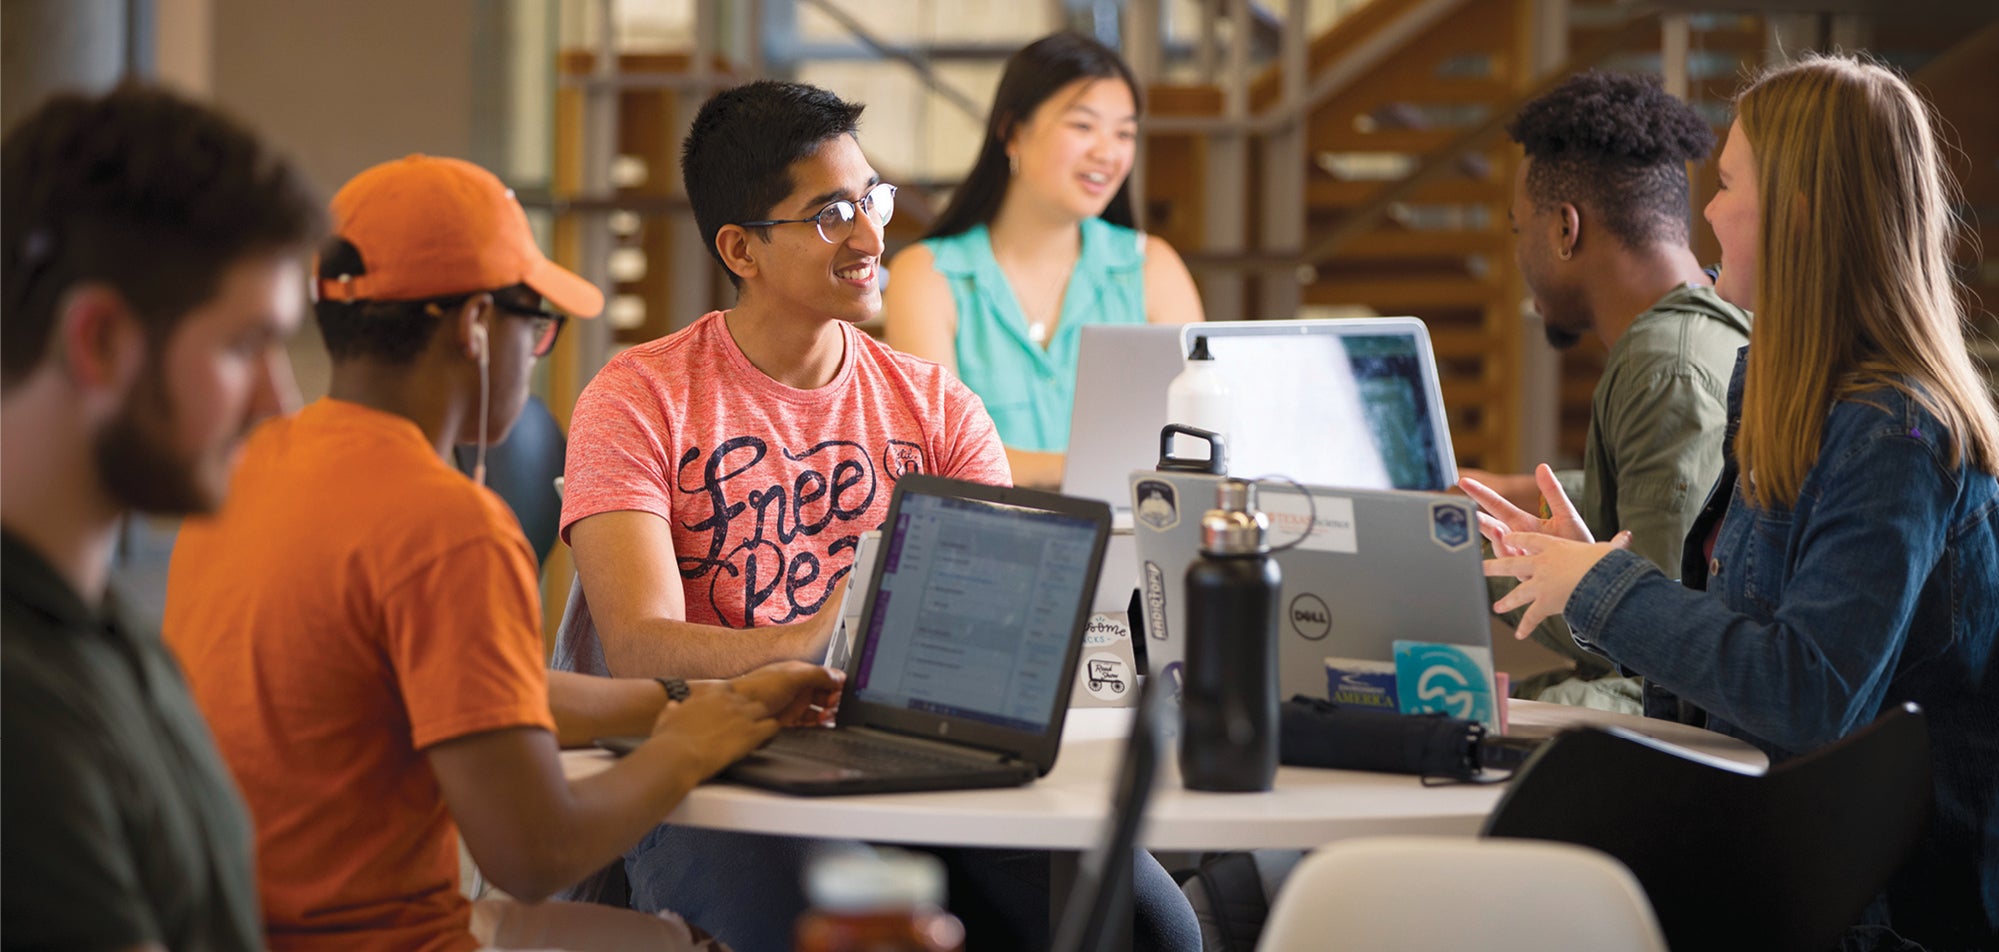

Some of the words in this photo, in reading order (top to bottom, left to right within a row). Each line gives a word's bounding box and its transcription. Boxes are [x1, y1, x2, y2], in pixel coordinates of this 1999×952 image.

[677, 436, 876, 579] Free
[1295, 610, 1326, 623] DELL
[1084, 621, 1126, 637] some
[1083, 635, 1105, 644] CKS
[1335, 691, 1394, 708] AMERICA
